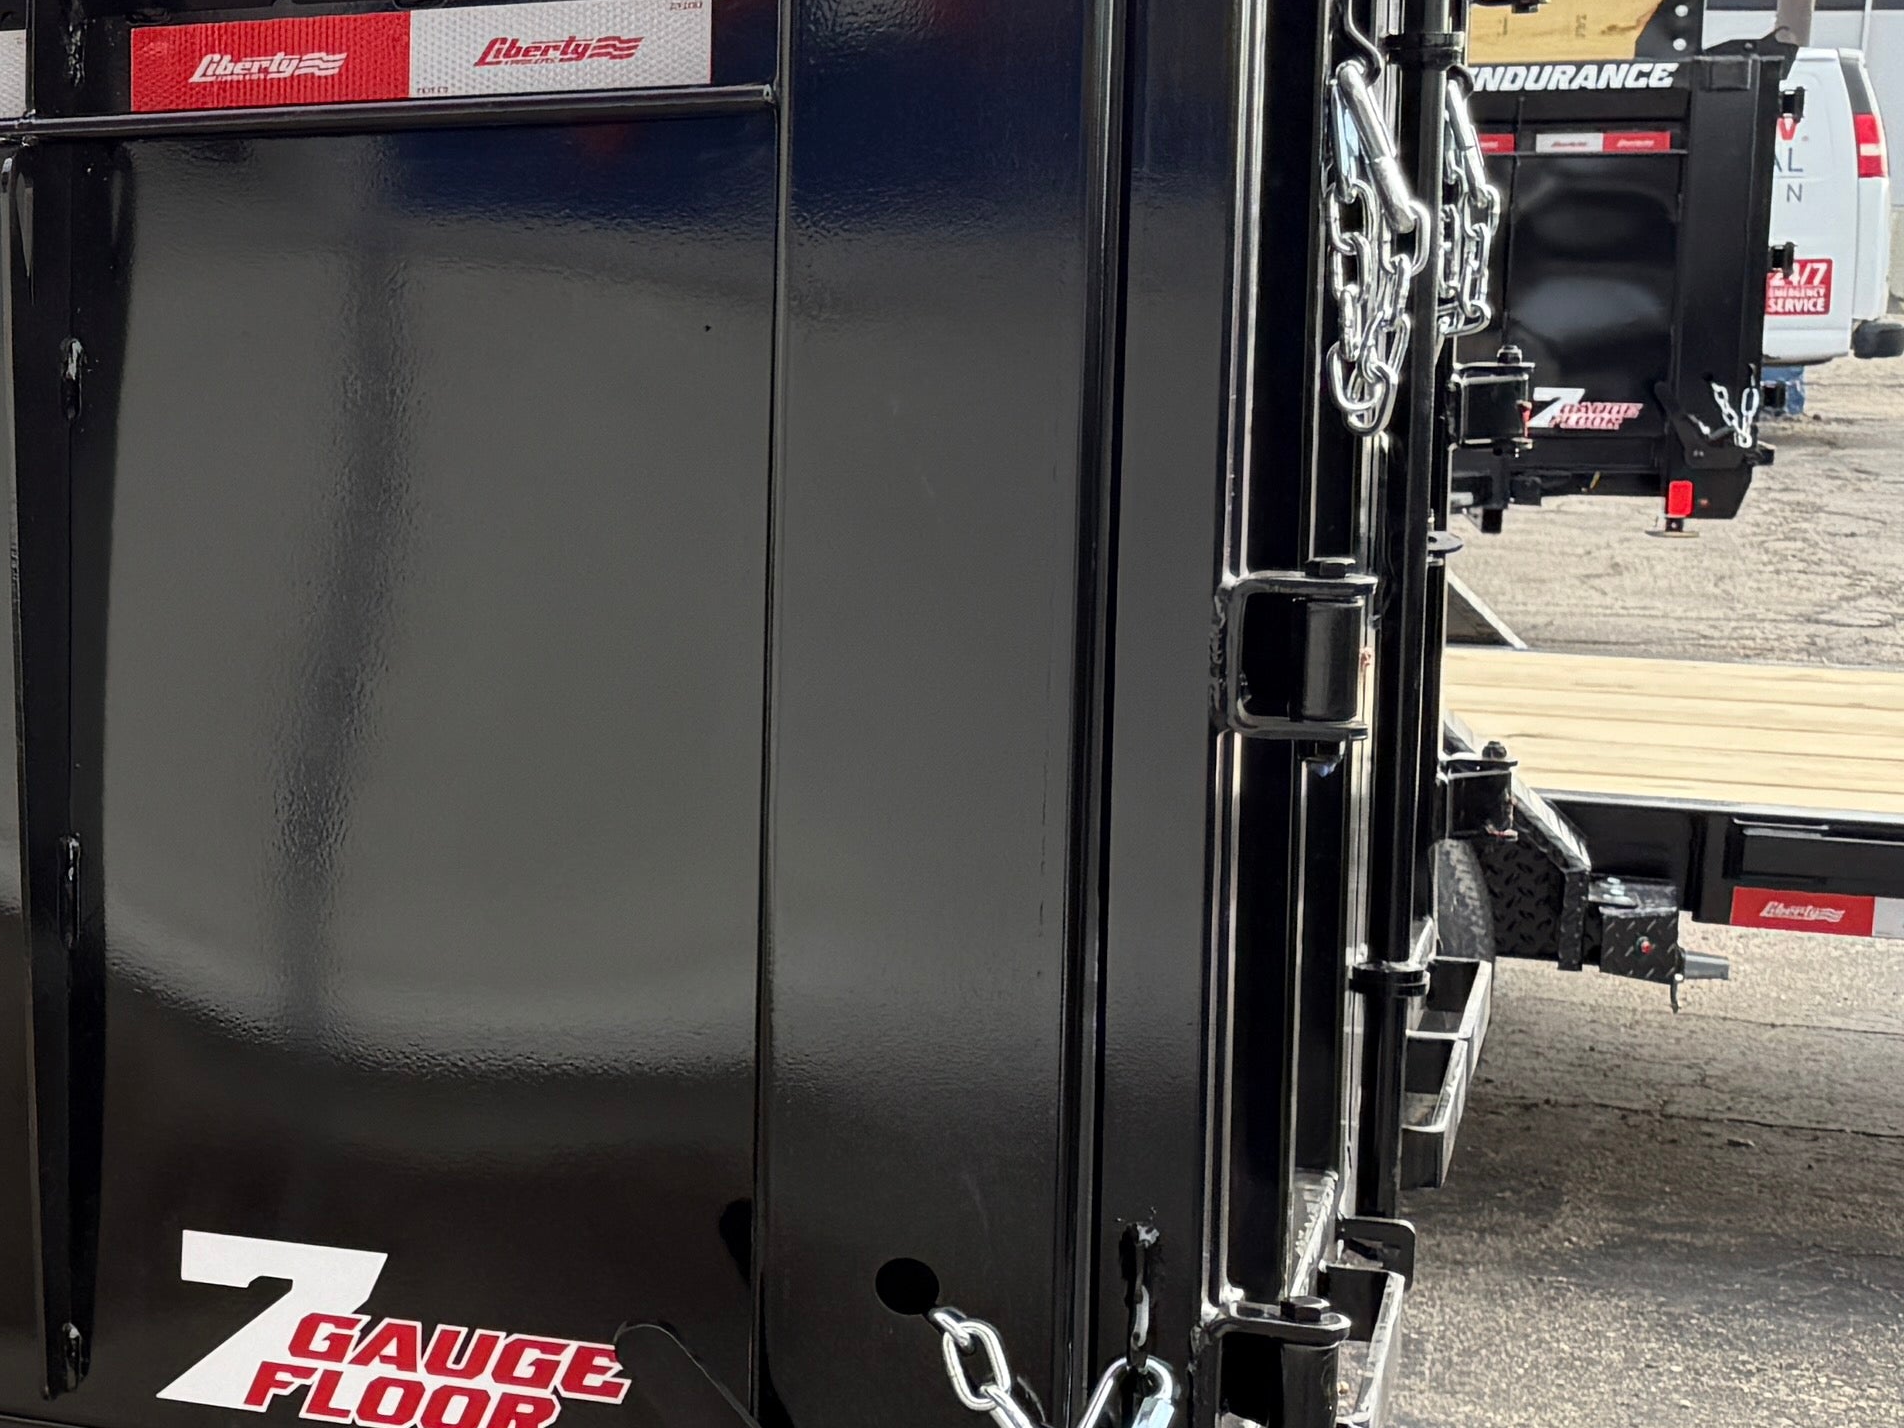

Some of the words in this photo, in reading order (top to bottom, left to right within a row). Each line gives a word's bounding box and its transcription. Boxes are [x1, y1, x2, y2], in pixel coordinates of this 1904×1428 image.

[474, 36, 594, 67] Liberty
[188, 52, 301, 83] Liberty
[1767, 298, 1825, 313] SERVICE
[1759, 901, 1820, 921] Liberty
[156, 1229, 388, 1411] 7
[288, 1310, 632, 1405] GAUGE
